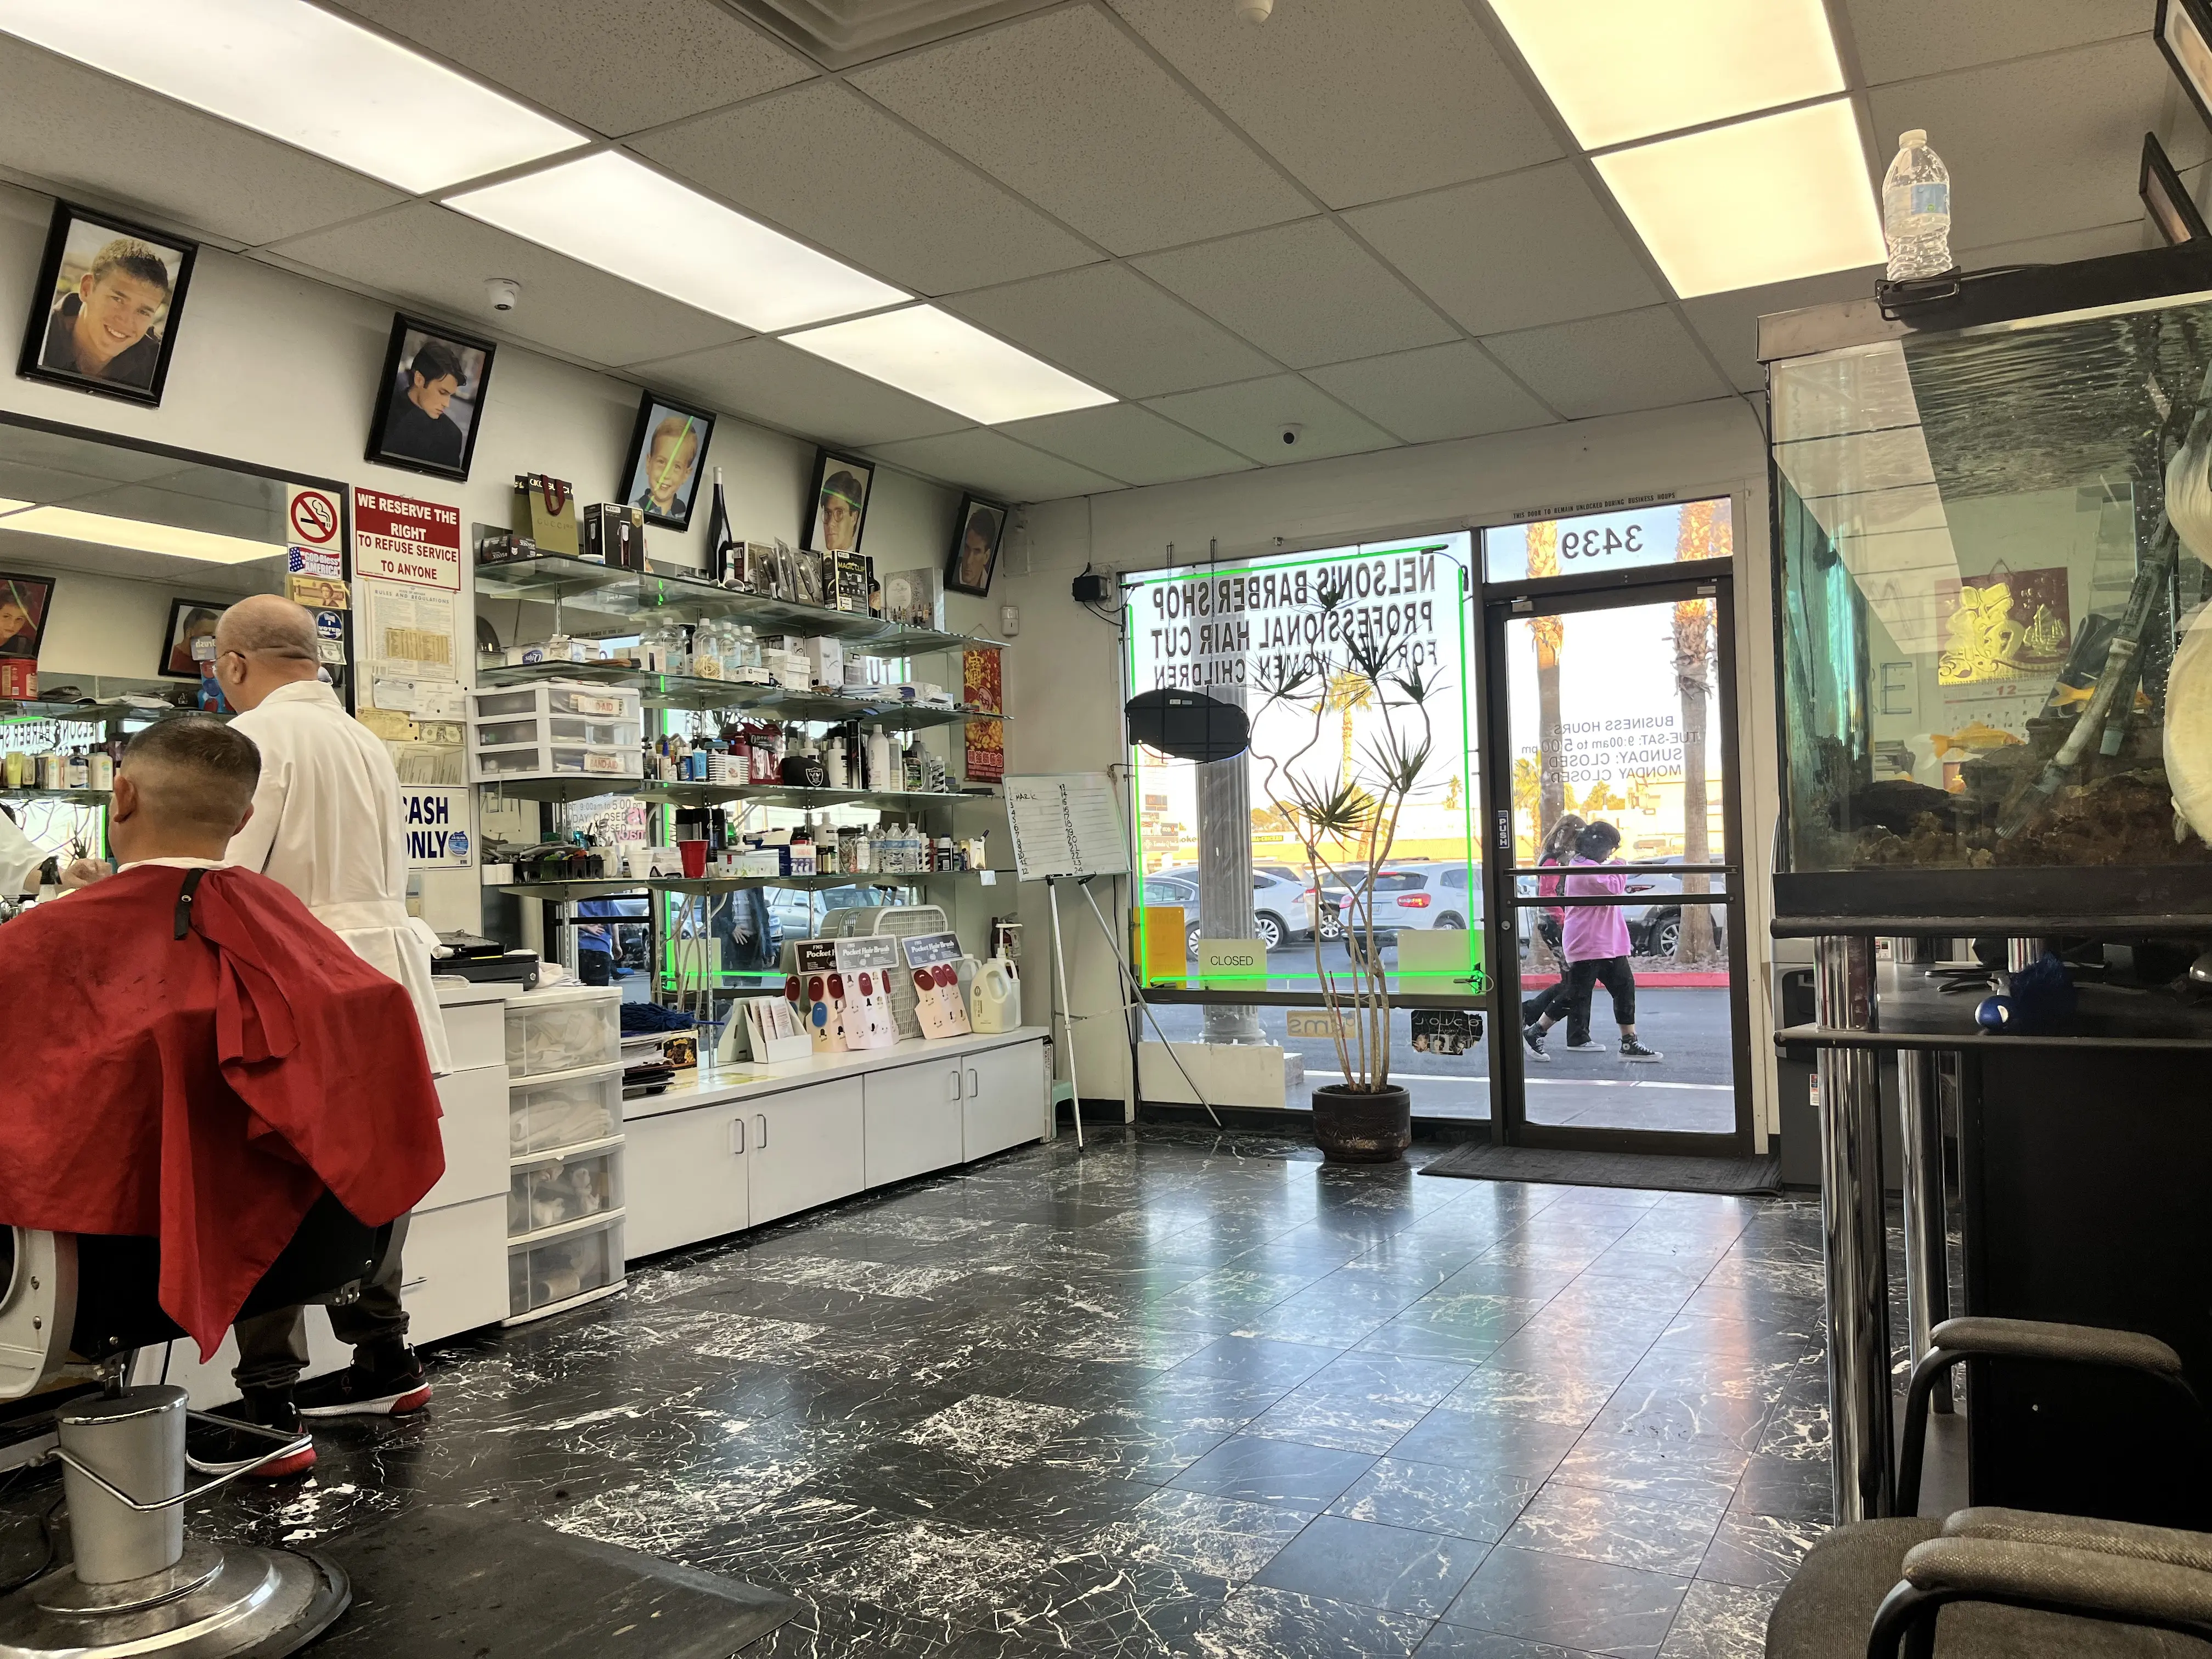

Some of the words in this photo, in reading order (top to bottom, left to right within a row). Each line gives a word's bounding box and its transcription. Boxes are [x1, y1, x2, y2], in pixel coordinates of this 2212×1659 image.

[1576, 503, 1602, 511] UNLOCKED
[1605, 499, 1624, 507] DURING
[1628, 495, 1654, 504] BUSINESS
[357, 493, 376, 509] WE
[379, 498, 431, 520] RESERVE
[434, 509, 456, 525] THE
[391, 522, 426, 541] RIGHT
[358, 534, 371, 547] TO
[375, 537, 413, 555] REFUSE
[416, 545, 456, 562] SERVICE
[305, 552, 318, 562] GOD
[304, 561, 338, 576] AMERICA
[381, 560, 394, 573] TO
[398, 563, 437, 580] ANYONE
[838, 561, 854, 570] MAGIC
[411, 595, 449, 604] REGULATIONS
[1996, 685, 2017, 696] 12
[590, 759, 618, 769] BAND-AID
[1015, 793, 1037, 802] MARK
[594, 812, 627, 822] CLOSED
[594, 824, 627, 834] COSED
[1498, 818, 1508, 846] PUSH
[1067, 836, 1077, 844] 20
[1069, 844, 1080, 852] 21
[843, 948, 861, 956] Pocket
[861, 946, 873, 955] Hair
[873, 945, 890, 953] Brush
[911, 945, 929, 953] Pocket
[928, 943, 940, 951] Hair
[940, 940, 955, 949] Brush
[1210, 955, 1254, 967] CLOSED
